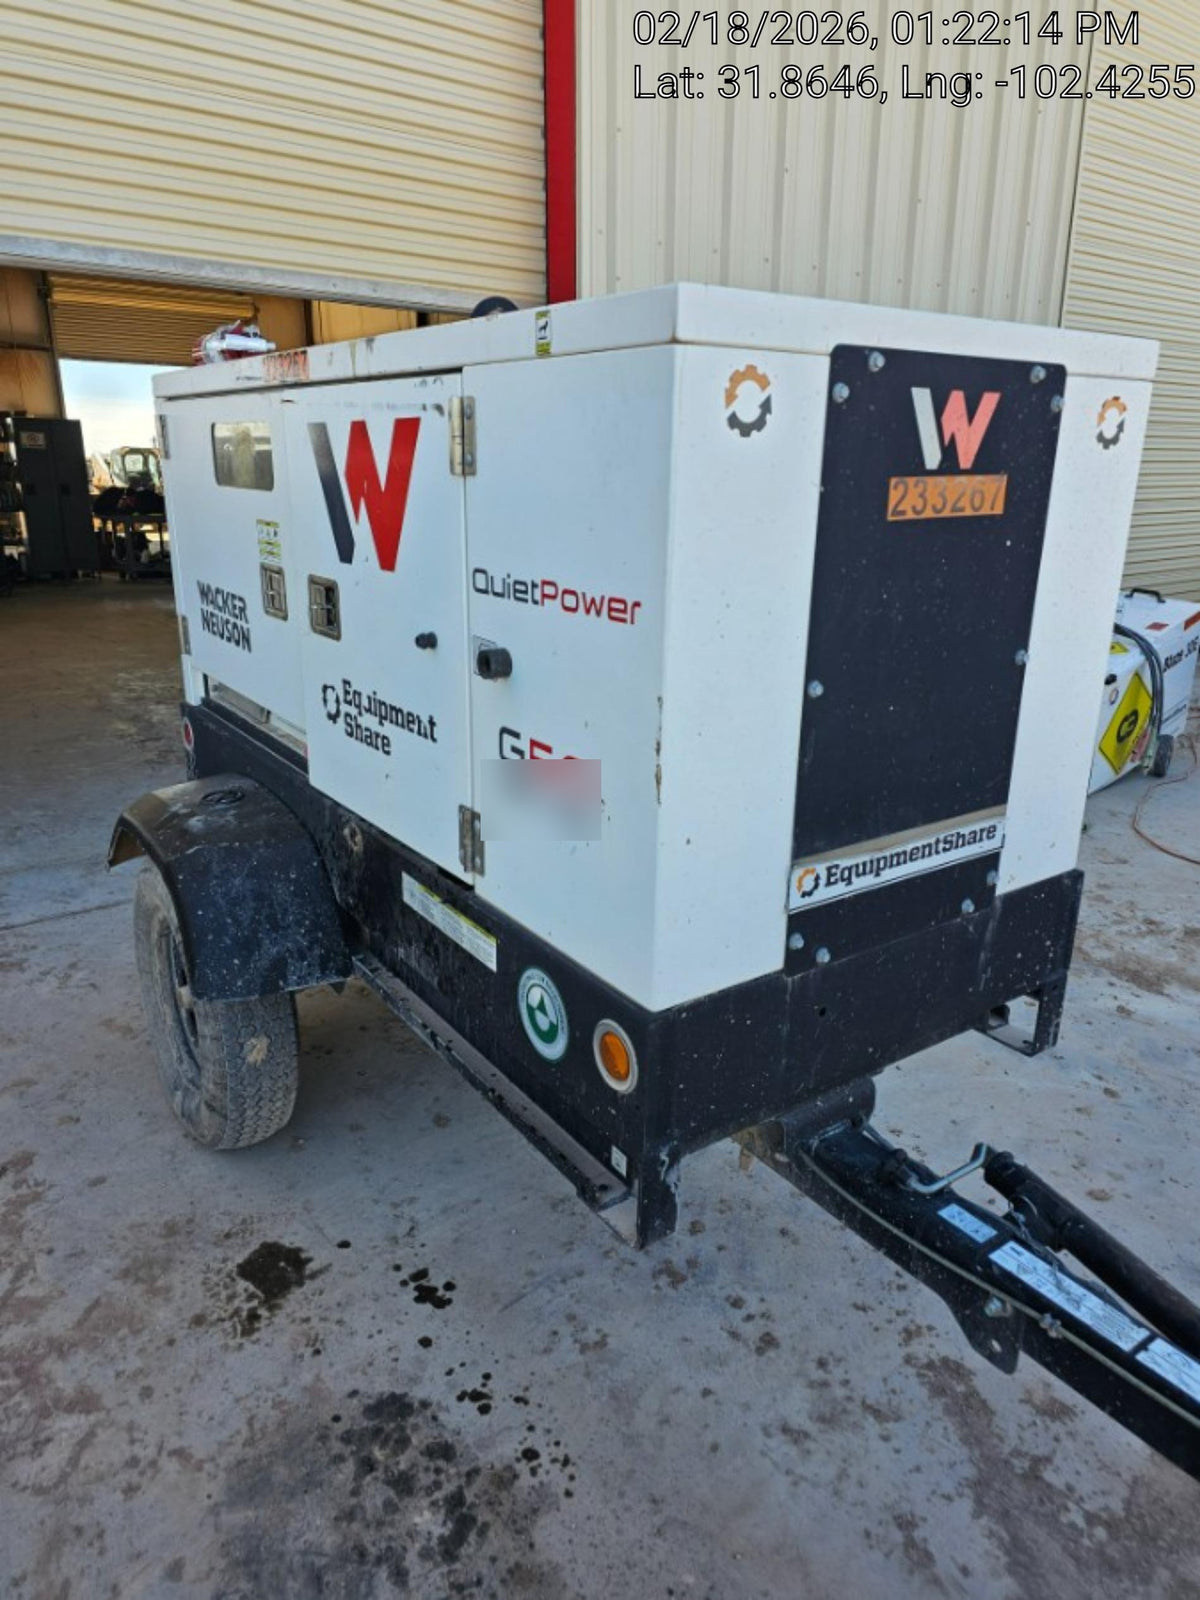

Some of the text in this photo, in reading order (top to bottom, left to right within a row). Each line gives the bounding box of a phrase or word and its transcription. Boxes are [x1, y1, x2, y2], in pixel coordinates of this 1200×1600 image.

[890, 477, 1004, 517] 233267
[196, 579, 249, 624] WACKER
[472, 567, 642, 625] QuietPower
[200, 607, 252, 653] NEUSON
[341, 677, 438, 743] Equipment
[343, 711, 392, 756] Share
[824, 823, 998, 887] EquipmentShare
